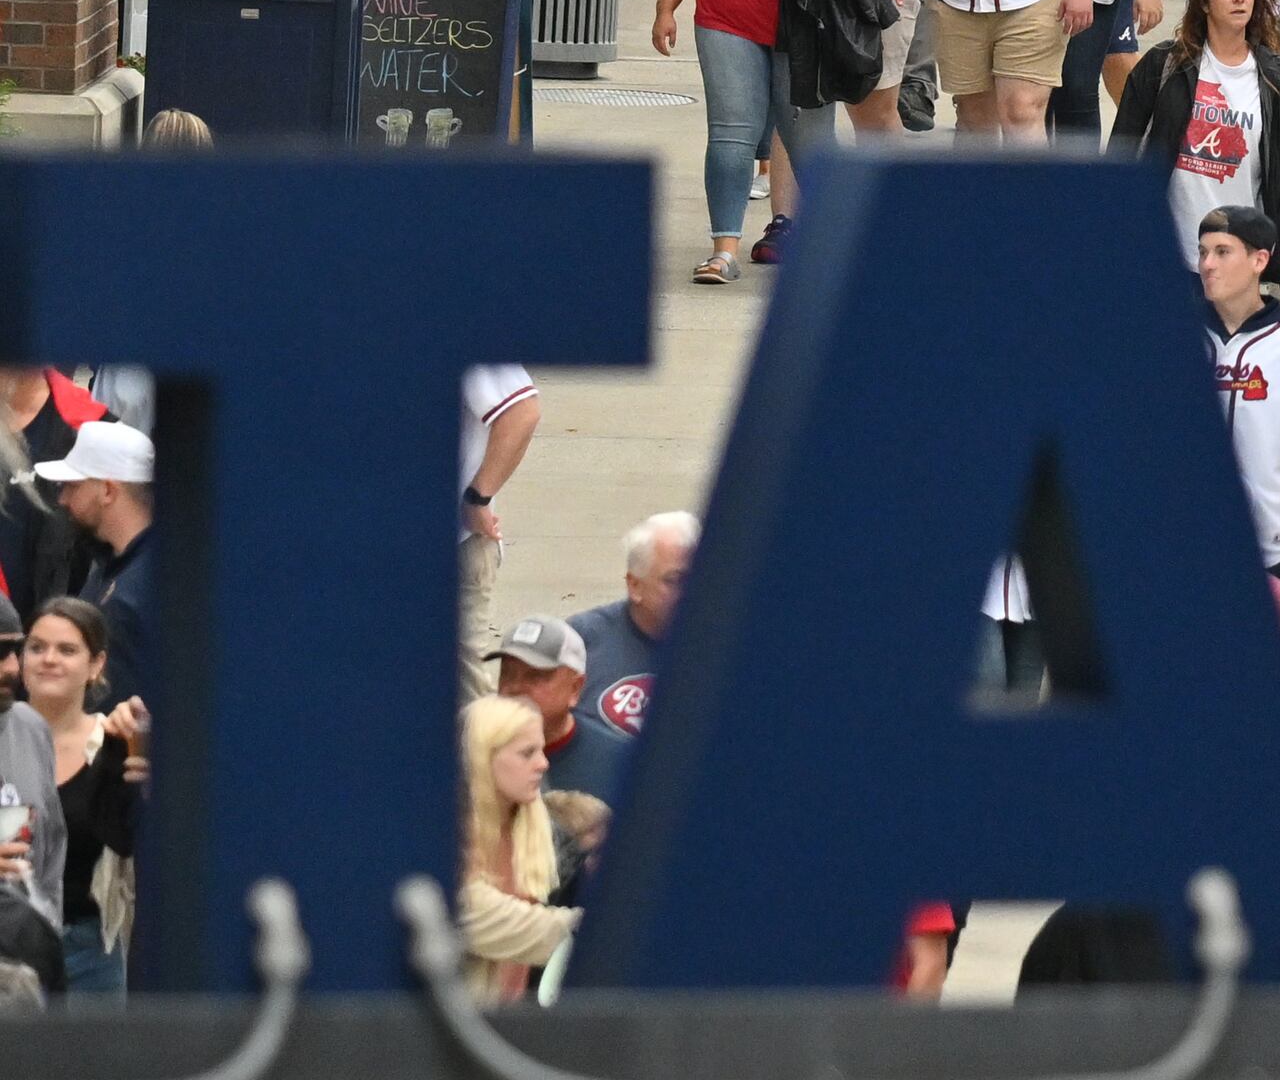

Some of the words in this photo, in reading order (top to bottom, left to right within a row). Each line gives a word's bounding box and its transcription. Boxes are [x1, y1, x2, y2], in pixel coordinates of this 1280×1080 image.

[362, 16, 493, 50] SELTZERS
[1118, 26, 1132, 42] A
[1191, 127, 1222, 159] A
[1181, 156, 1205, 168] WORLD
[1206, 160, 1228, 171] SERIES
